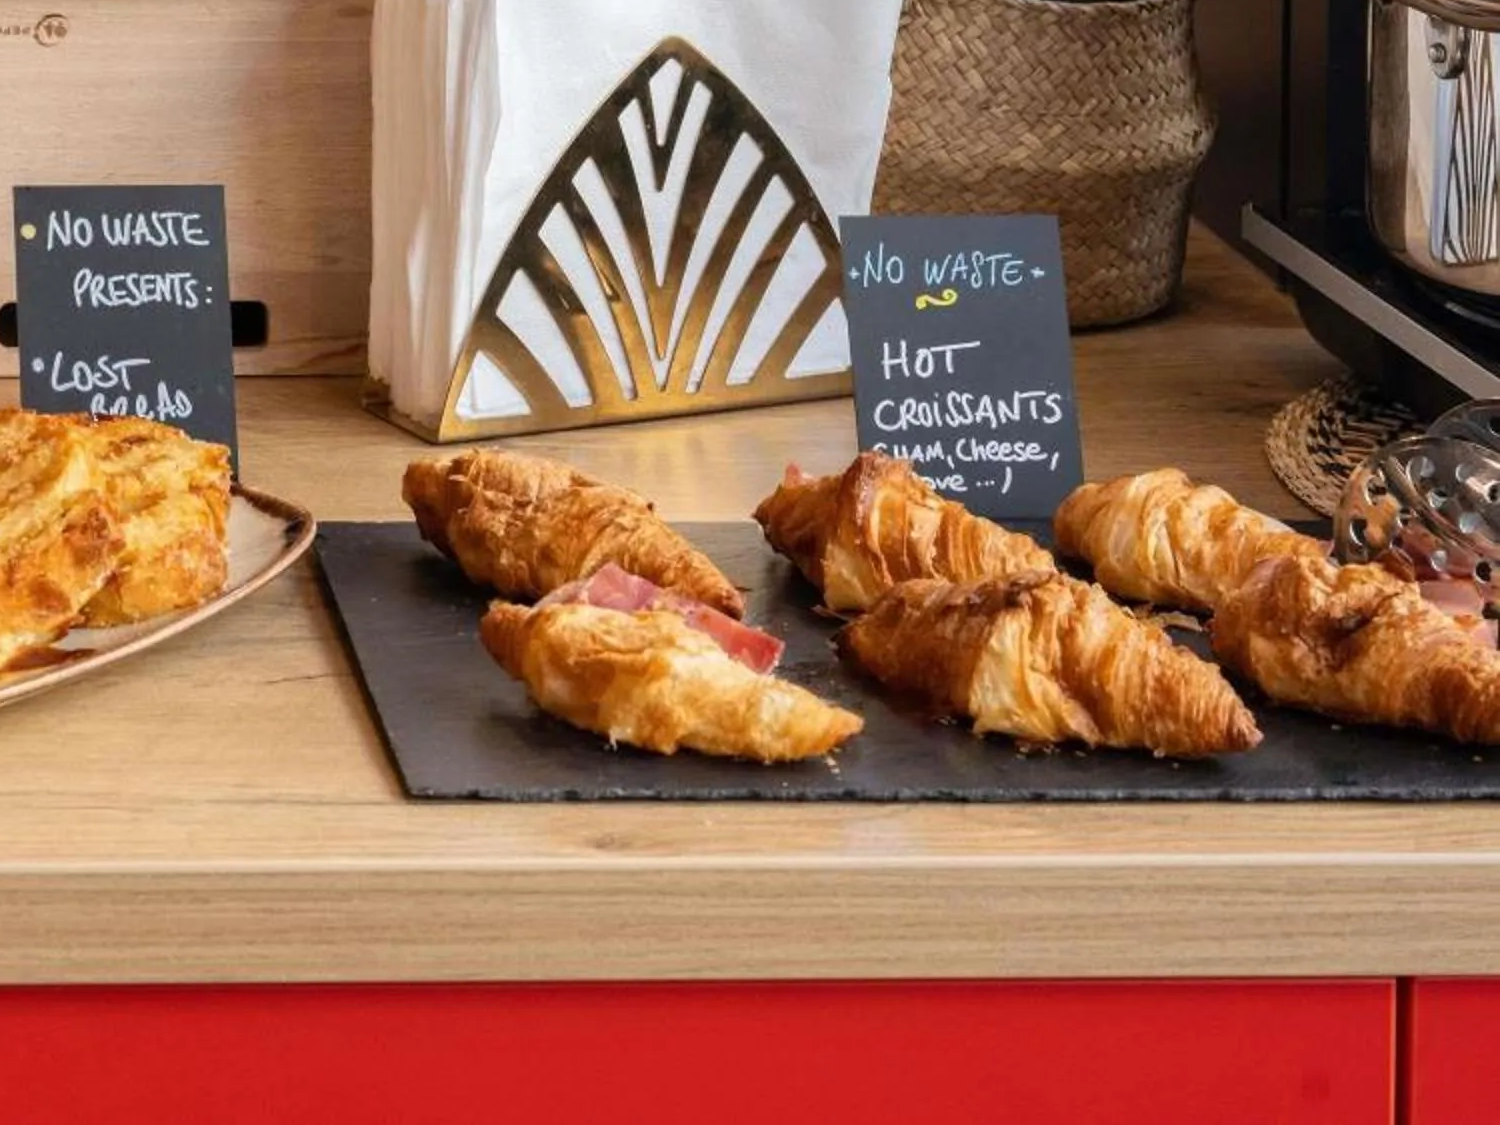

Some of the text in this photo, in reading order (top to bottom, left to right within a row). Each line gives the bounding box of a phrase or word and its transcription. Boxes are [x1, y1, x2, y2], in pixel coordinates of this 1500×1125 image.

[47, 210, 210, 251] NO WASTE
[863, 242, 1024, 289] NO WASTE
[51, 351, 151, 392] LOST
[882, 340, 981, 379] HOT
